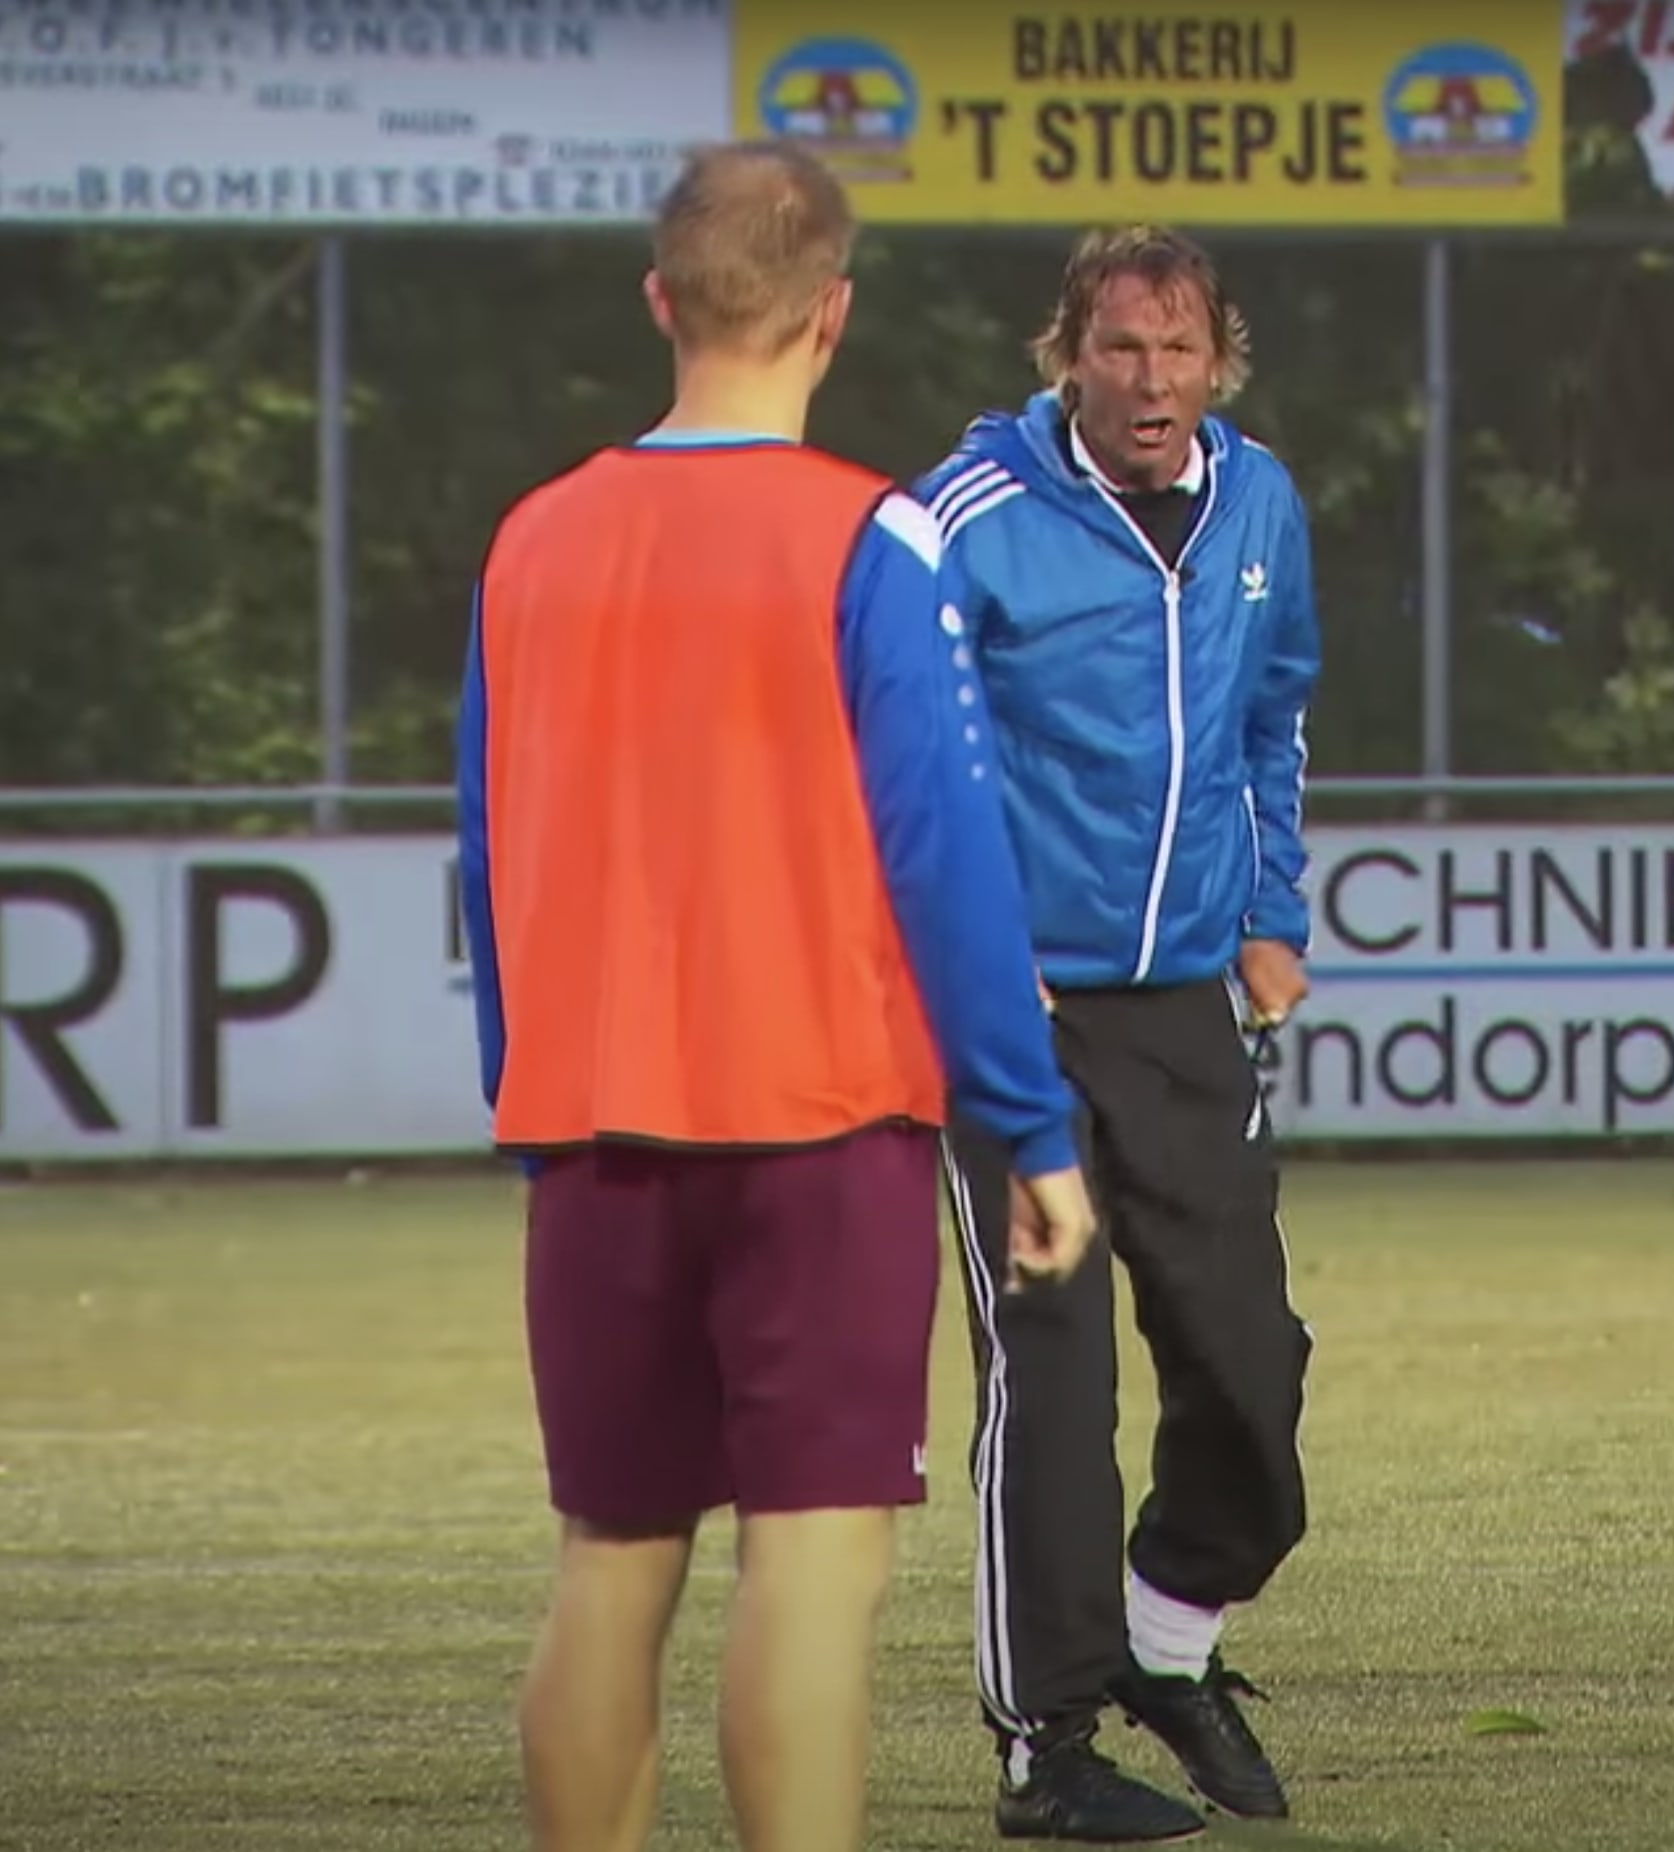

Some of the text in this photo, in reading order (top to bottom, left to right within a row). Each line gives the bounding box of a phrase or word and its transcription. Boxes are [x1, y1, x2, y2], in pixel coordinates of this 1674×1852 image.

[270, 17, 598, 60] TONGEREN
[1014, 19, 1296, 81] BAKKERIJ
[943, 101, 1369, 185] 'T STOEPJE
